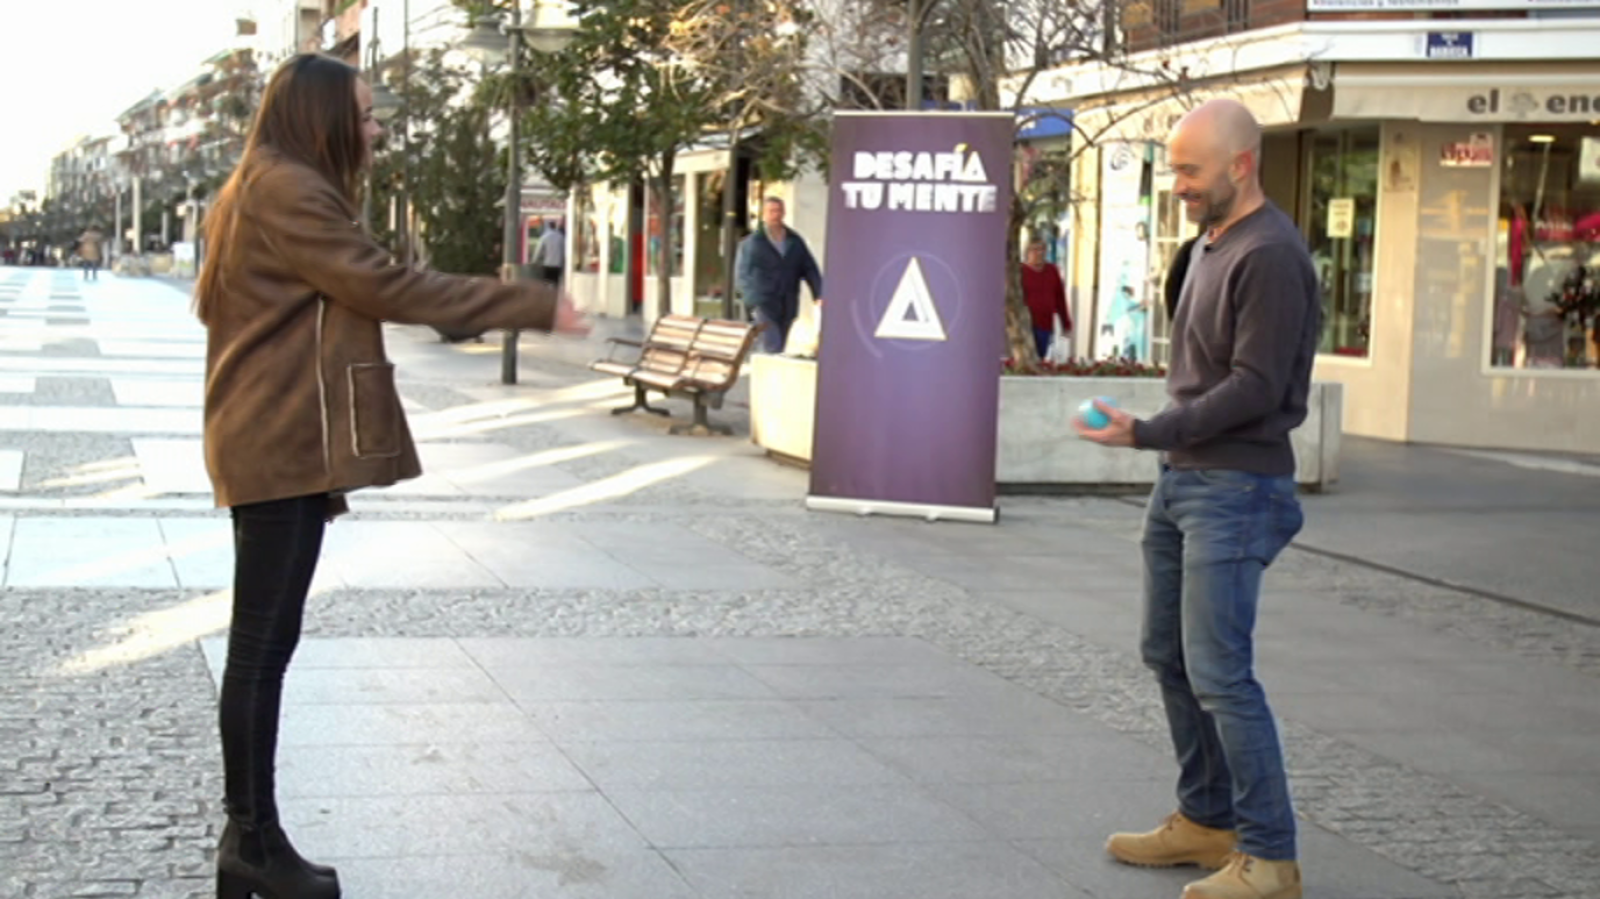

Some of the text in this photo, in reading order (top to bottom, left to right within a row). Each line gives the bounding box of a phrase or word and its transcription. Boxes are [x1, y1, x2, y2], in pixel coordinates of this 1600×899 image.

[1466, 88, 1500, 115] el
[852, 142, 989, 183] DESAFÍA
[840, 181, 998, 213] TU MENTE
